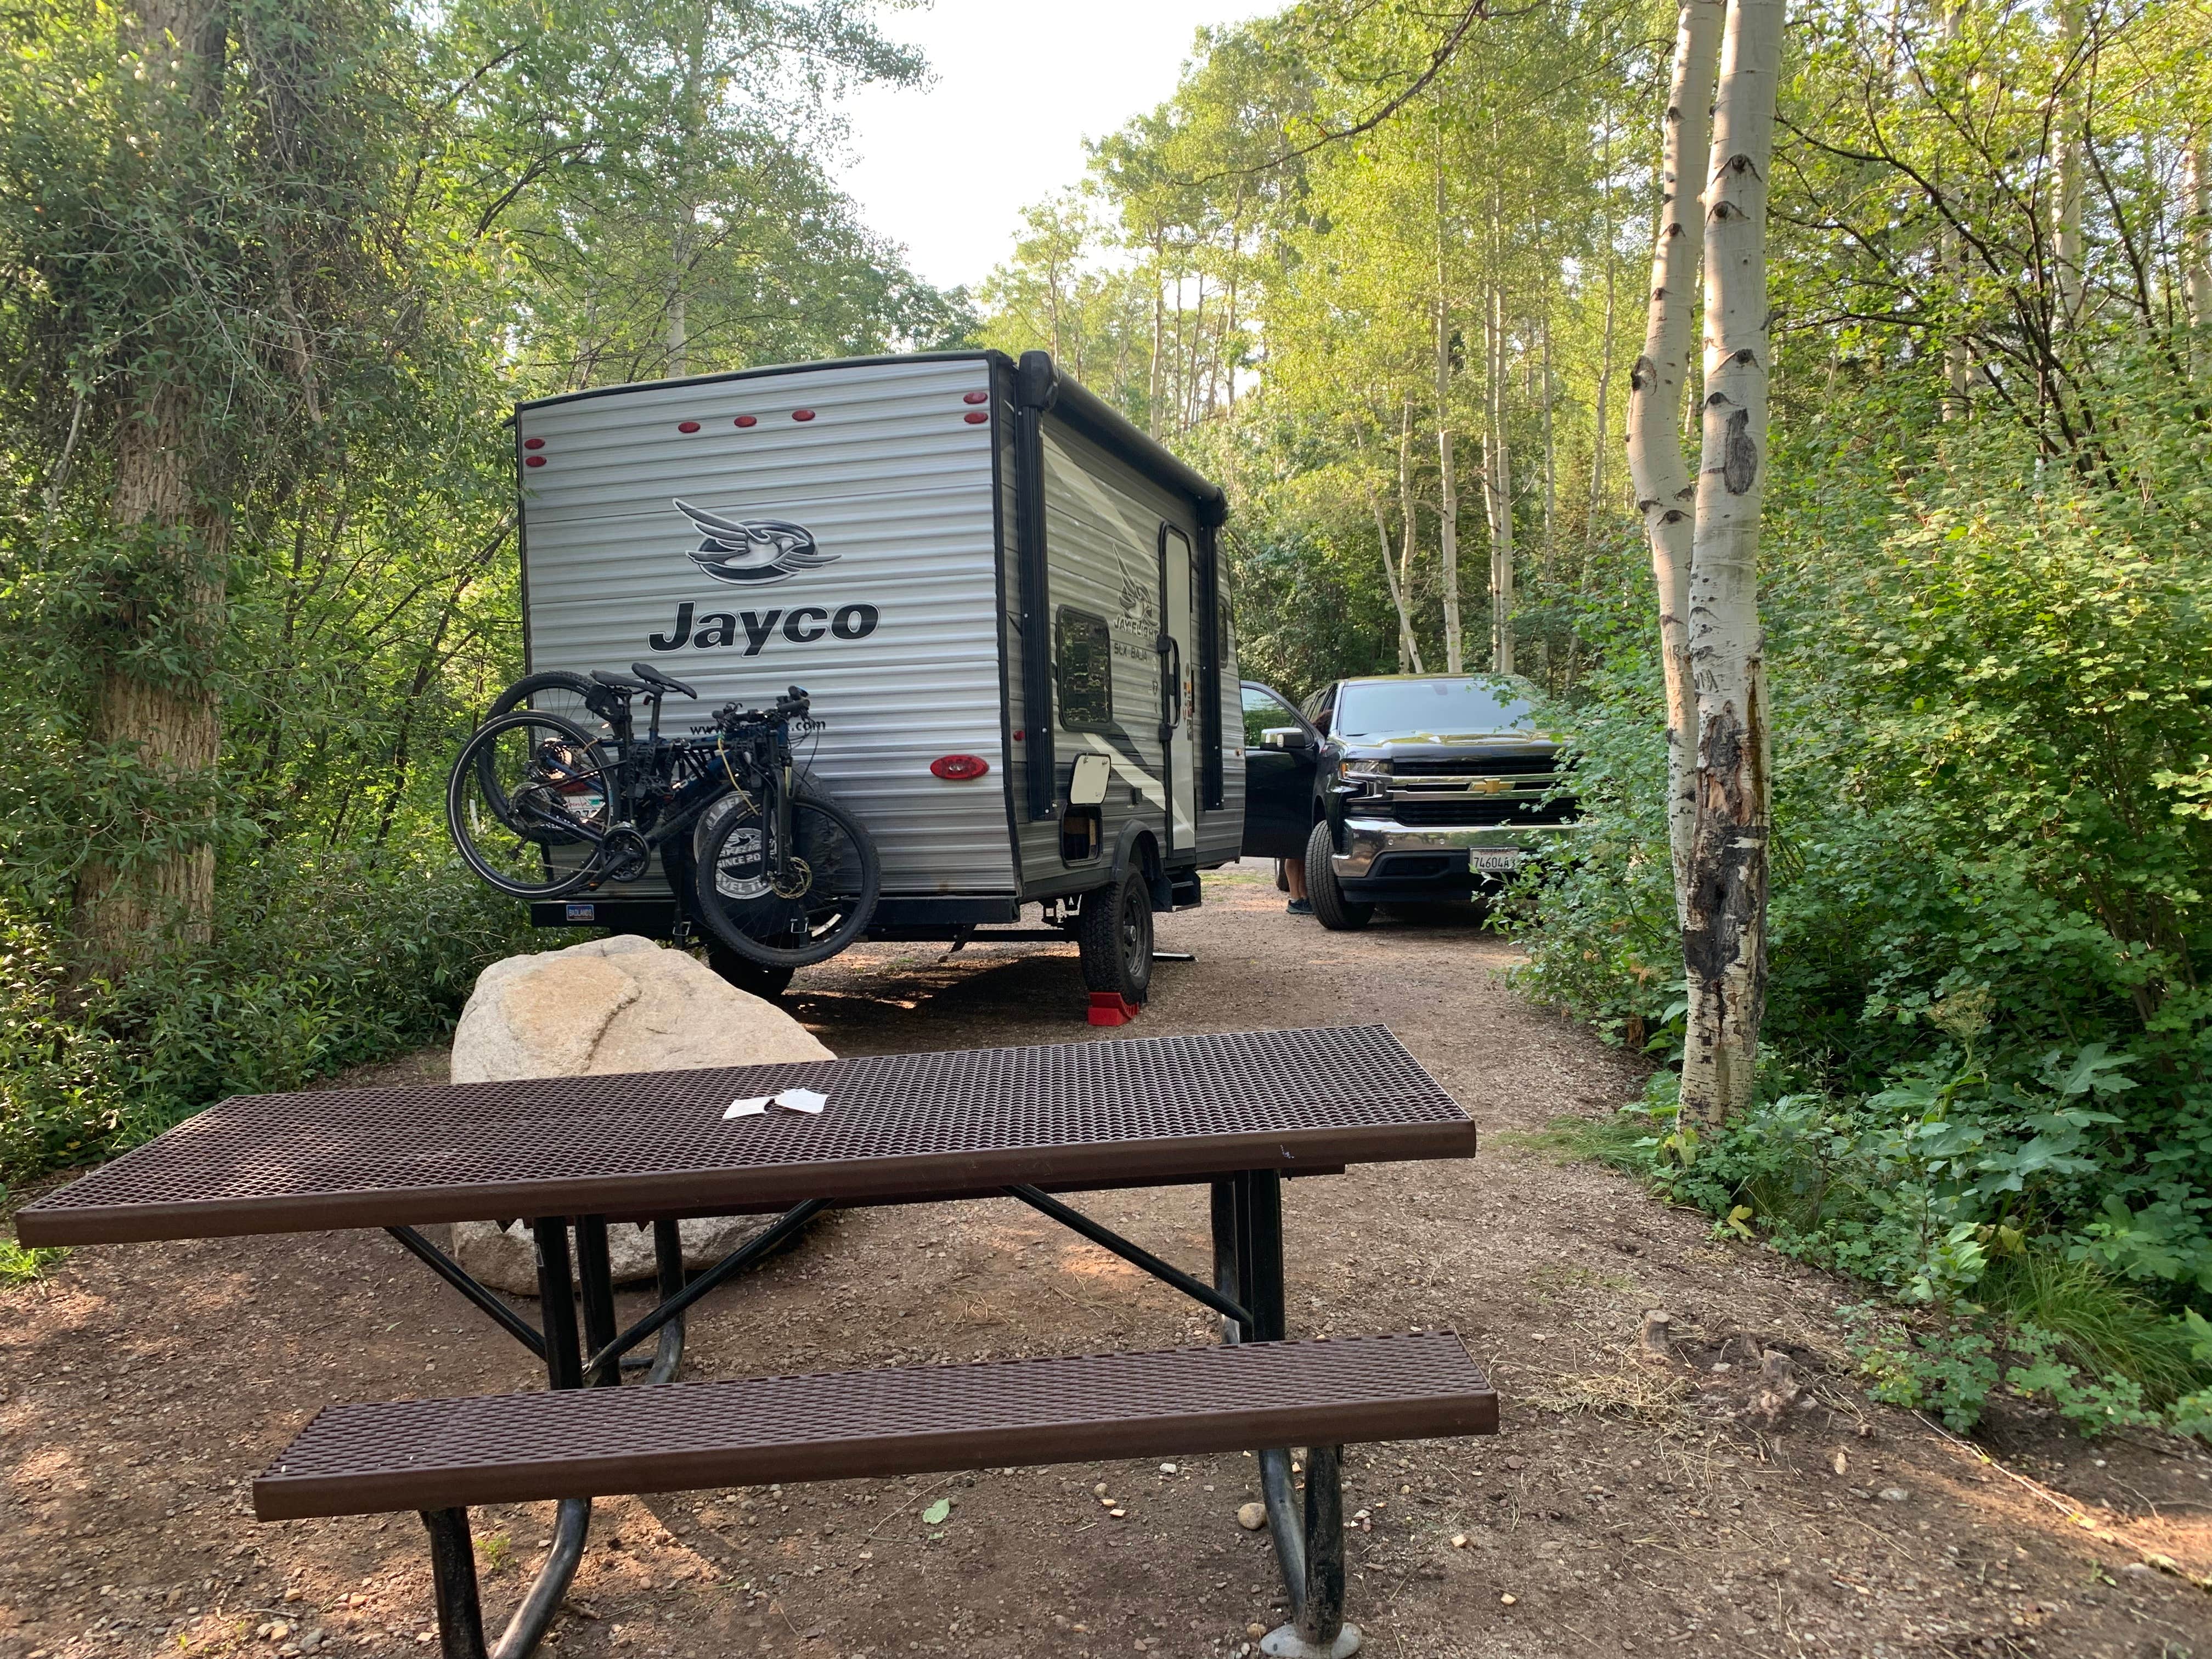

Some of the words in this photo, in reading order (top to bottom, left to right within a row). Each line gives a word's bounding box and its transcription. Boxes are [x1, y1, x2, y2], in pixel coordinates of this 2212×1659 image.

[647, 601, 881, 658] Jayco
[1114, 642, 1127, 657] SLX
[1131, 647, 1147, 662] BAJA
[716, 856, 745, 868] SINCE
